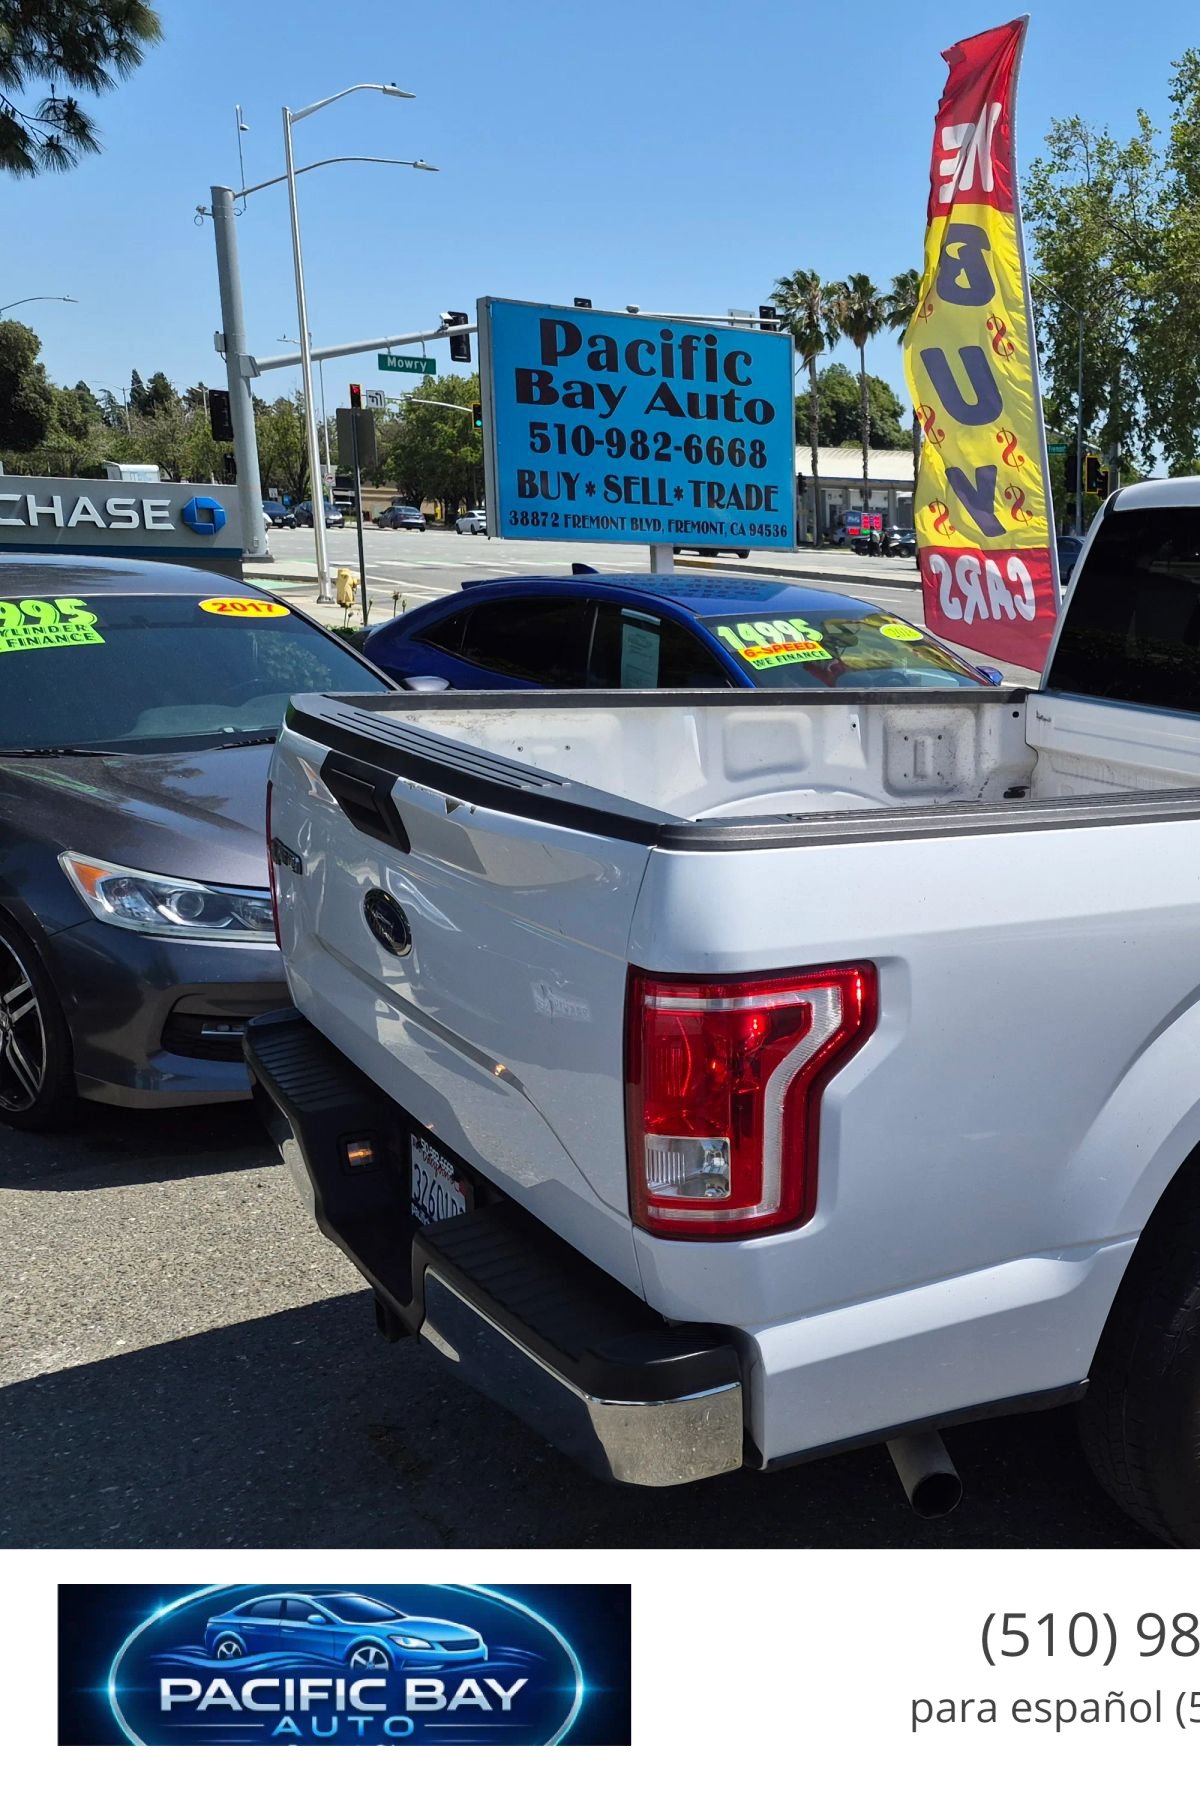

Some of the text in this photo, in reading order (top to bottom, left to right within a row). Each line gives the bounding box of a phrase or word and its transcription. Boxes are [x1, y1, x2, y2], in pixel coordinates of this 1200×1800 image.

[387, 356, 428, 373] Mowry
[539, 317, 753, 387] Pacific
[514, 367, 775, 425] Bay Auto
[529, 421, 768, 470] 510-982-6668
[517, 469, 779, 512] BUY SELL TRADE
[0, 493, 175, 531] CHASE
[508, 510, 788, 538] 38872 FREMONT BLVD, FREMONT, CA 94536
[212, 602, 275, 613] 2017
[6, 632, 95, 648] FINANCE
[717, 618, 824, 650] 14995
[743, 641, 818, 659] 6-SPEED
[752, 650, 826, 668] WE FINANCE
